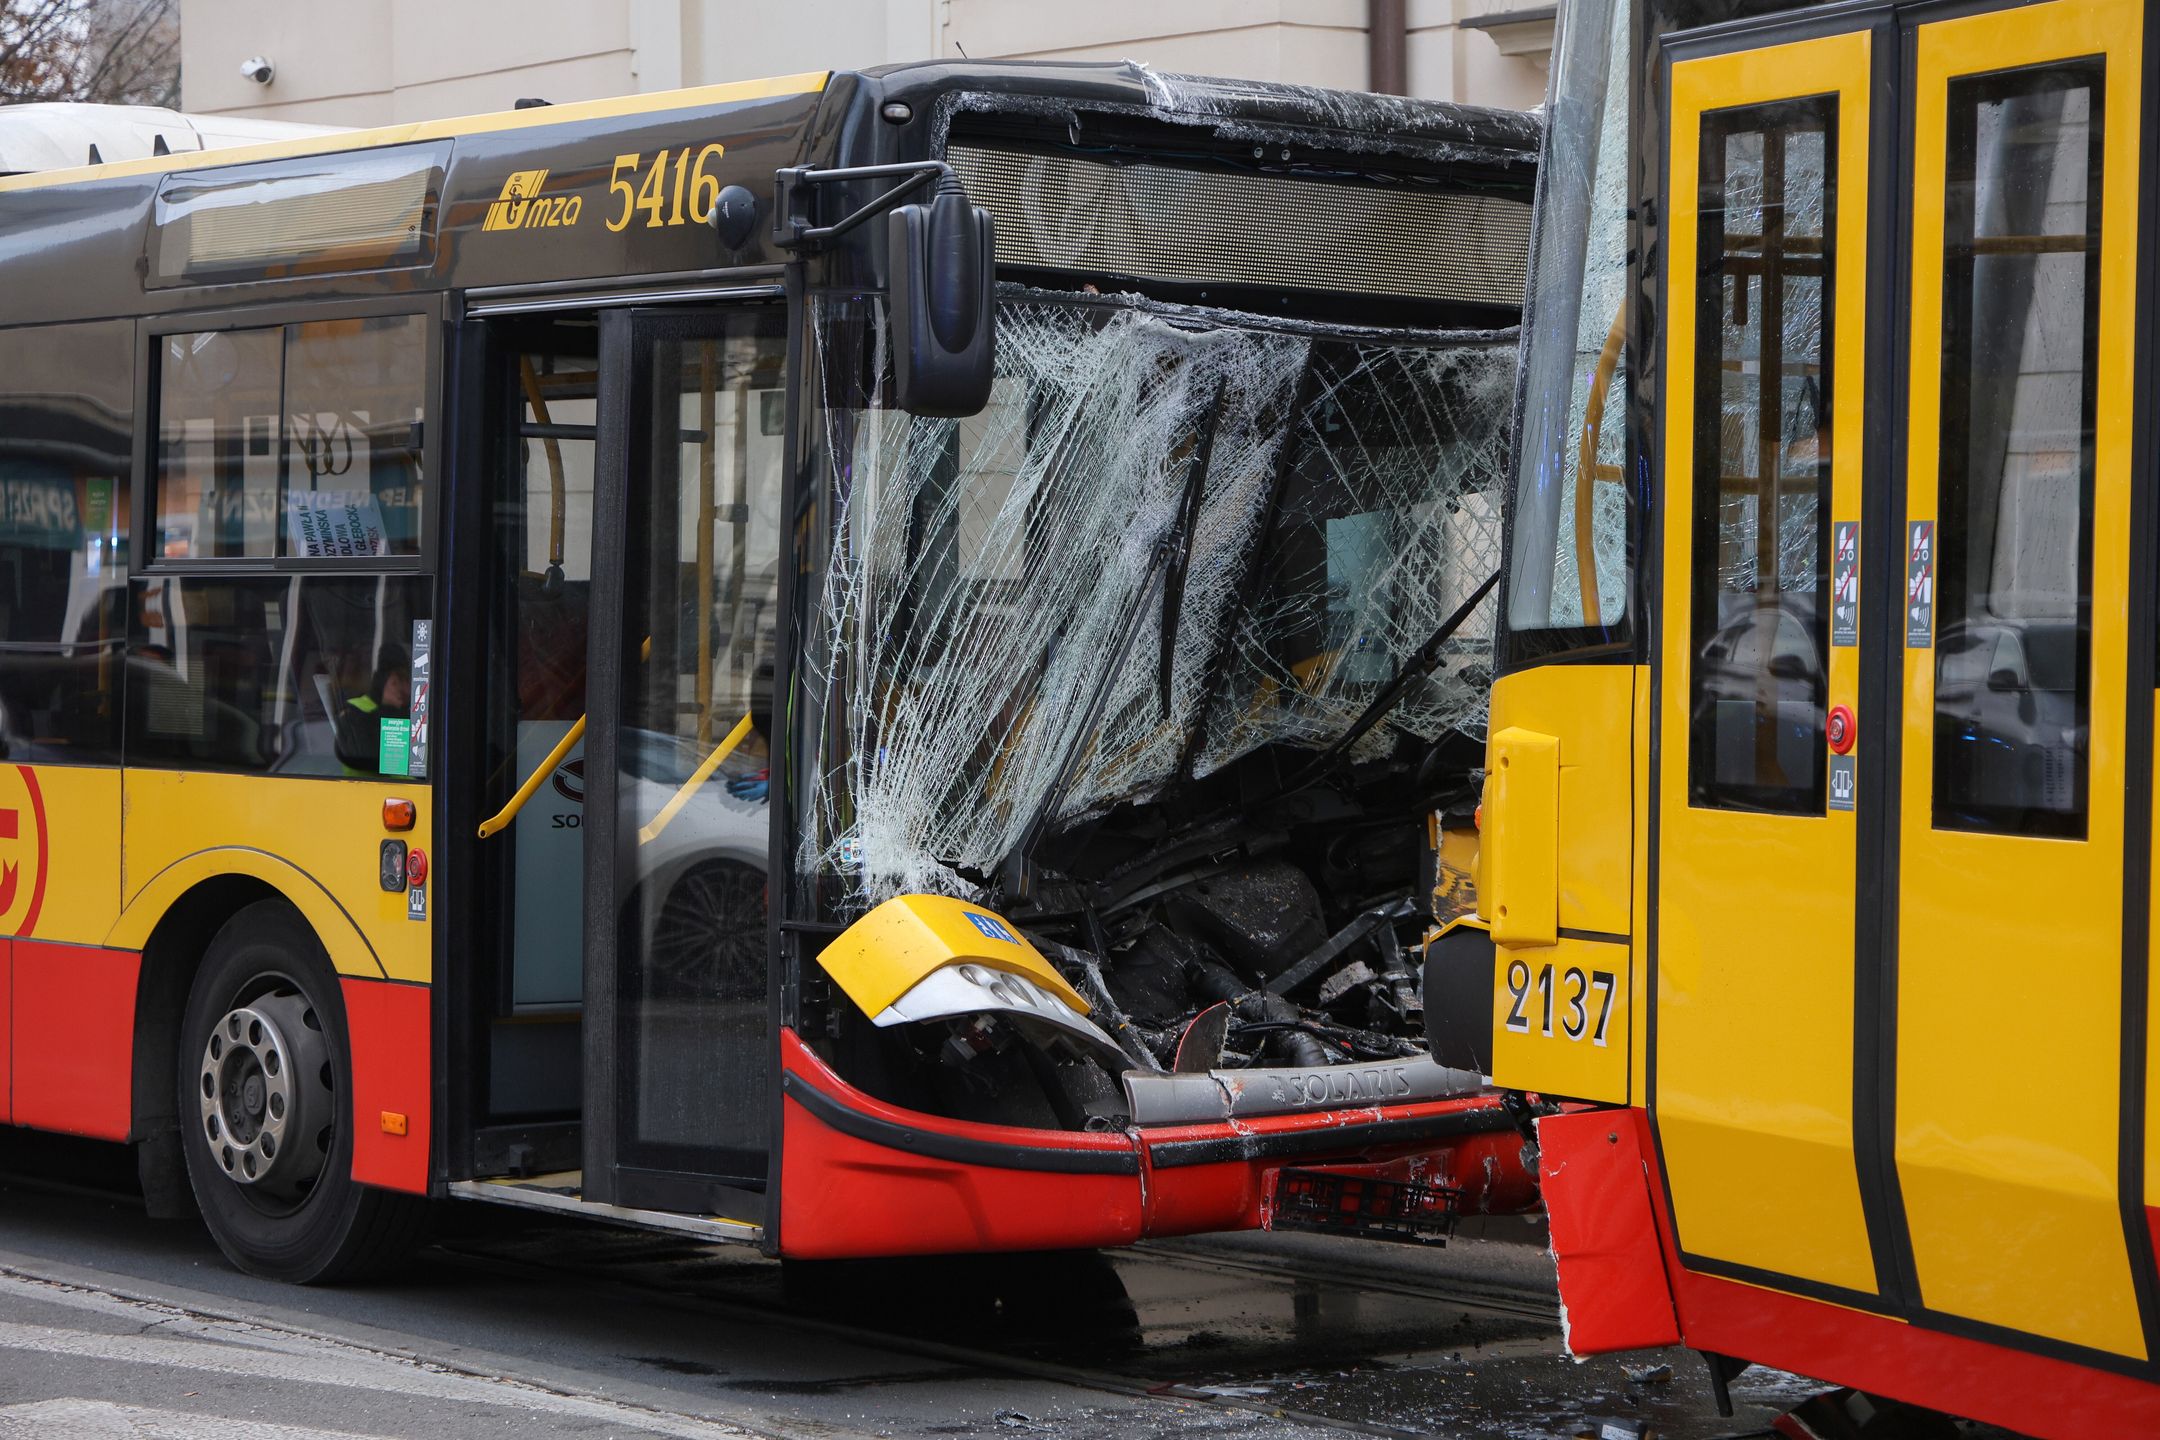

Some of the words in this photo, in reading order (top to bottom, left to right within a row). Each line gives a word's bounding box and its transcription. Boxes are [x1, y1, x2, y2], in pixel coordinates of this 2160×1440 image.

[605, 143, 725, 232] 5416
[525, 196, 582, 228] mza
[308, 543, 321, 556] NA
[1505, 959, 1617, 1048] 2137
[1289, 1067, 1411, 1106] SOLARIS
